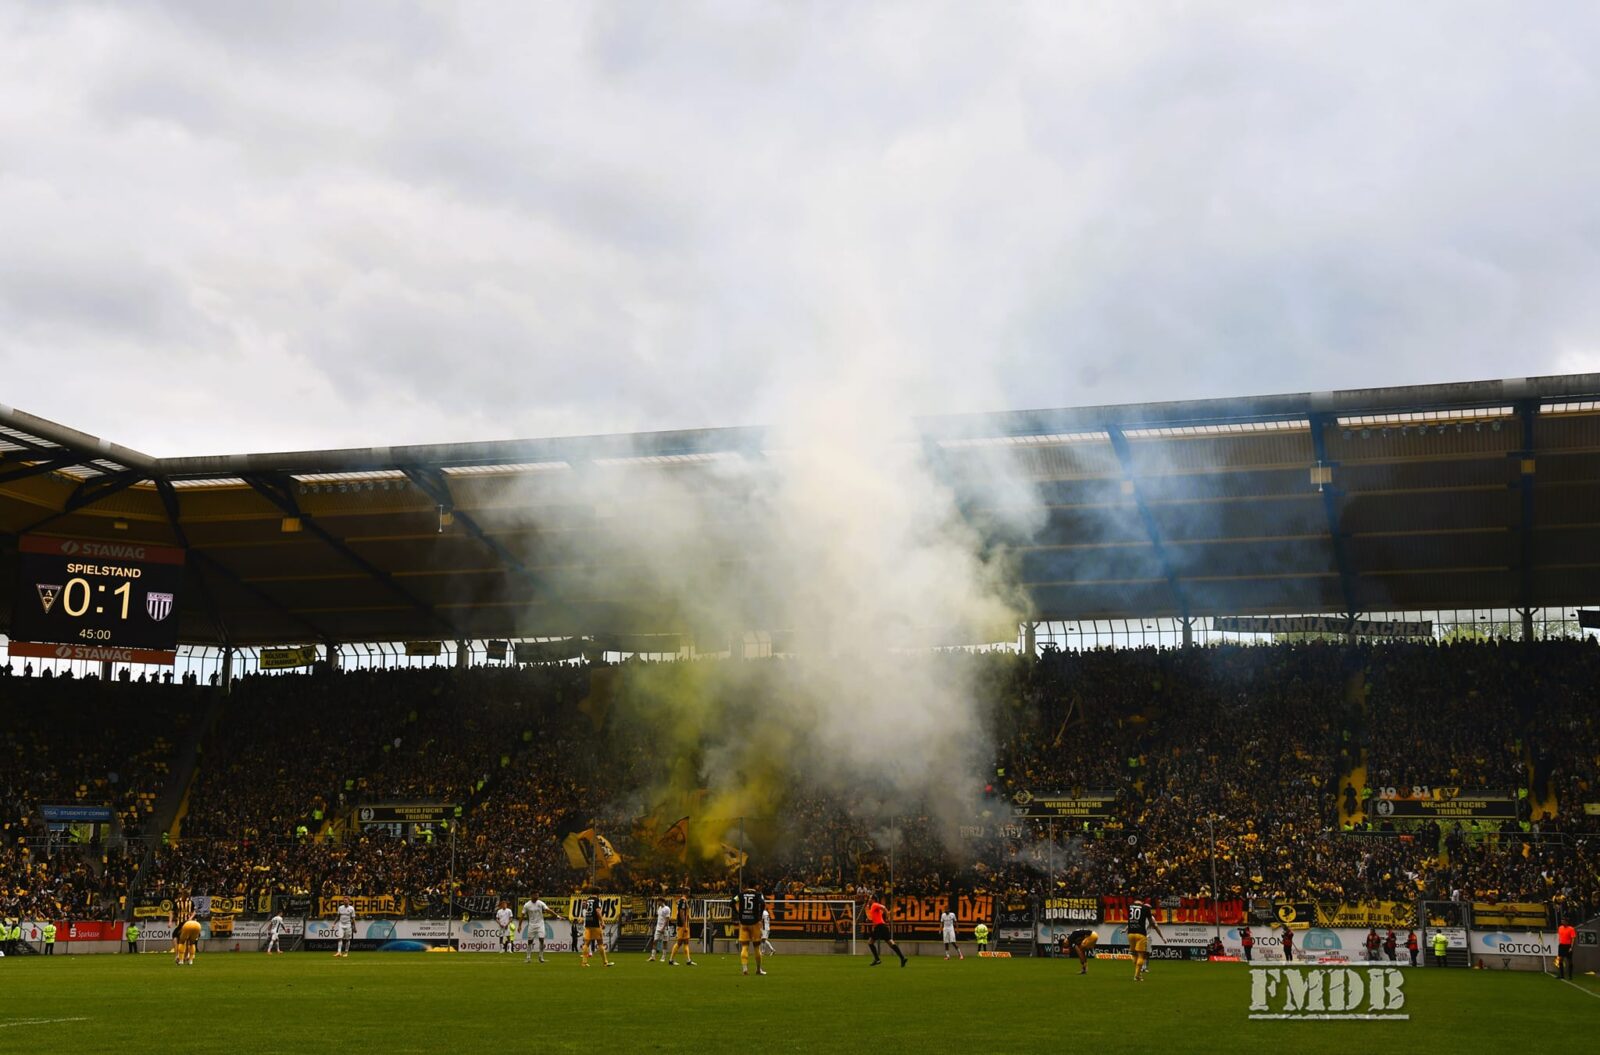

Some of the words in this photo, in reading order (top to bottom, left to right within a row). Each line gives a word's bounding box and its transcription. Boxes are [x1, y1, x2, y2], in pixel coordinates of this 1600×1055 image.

[82, 543, 145, 559] STAWAG
[67, 563, 142, 578] SPIELSTAND
[63, 577, 132, 620] 0:1
[79, 629, 111, 640] 45:00
[75, 649, 132, 661] STAWAG
[744, 896, 754, 910] 15
[1045, 908, 1098, 920] HOOLIGANS
[1129, 908, 1141, 920] 30
[467, 942, 488, 951] regio
[1499, 943, 1552, 954] ROTCOM
